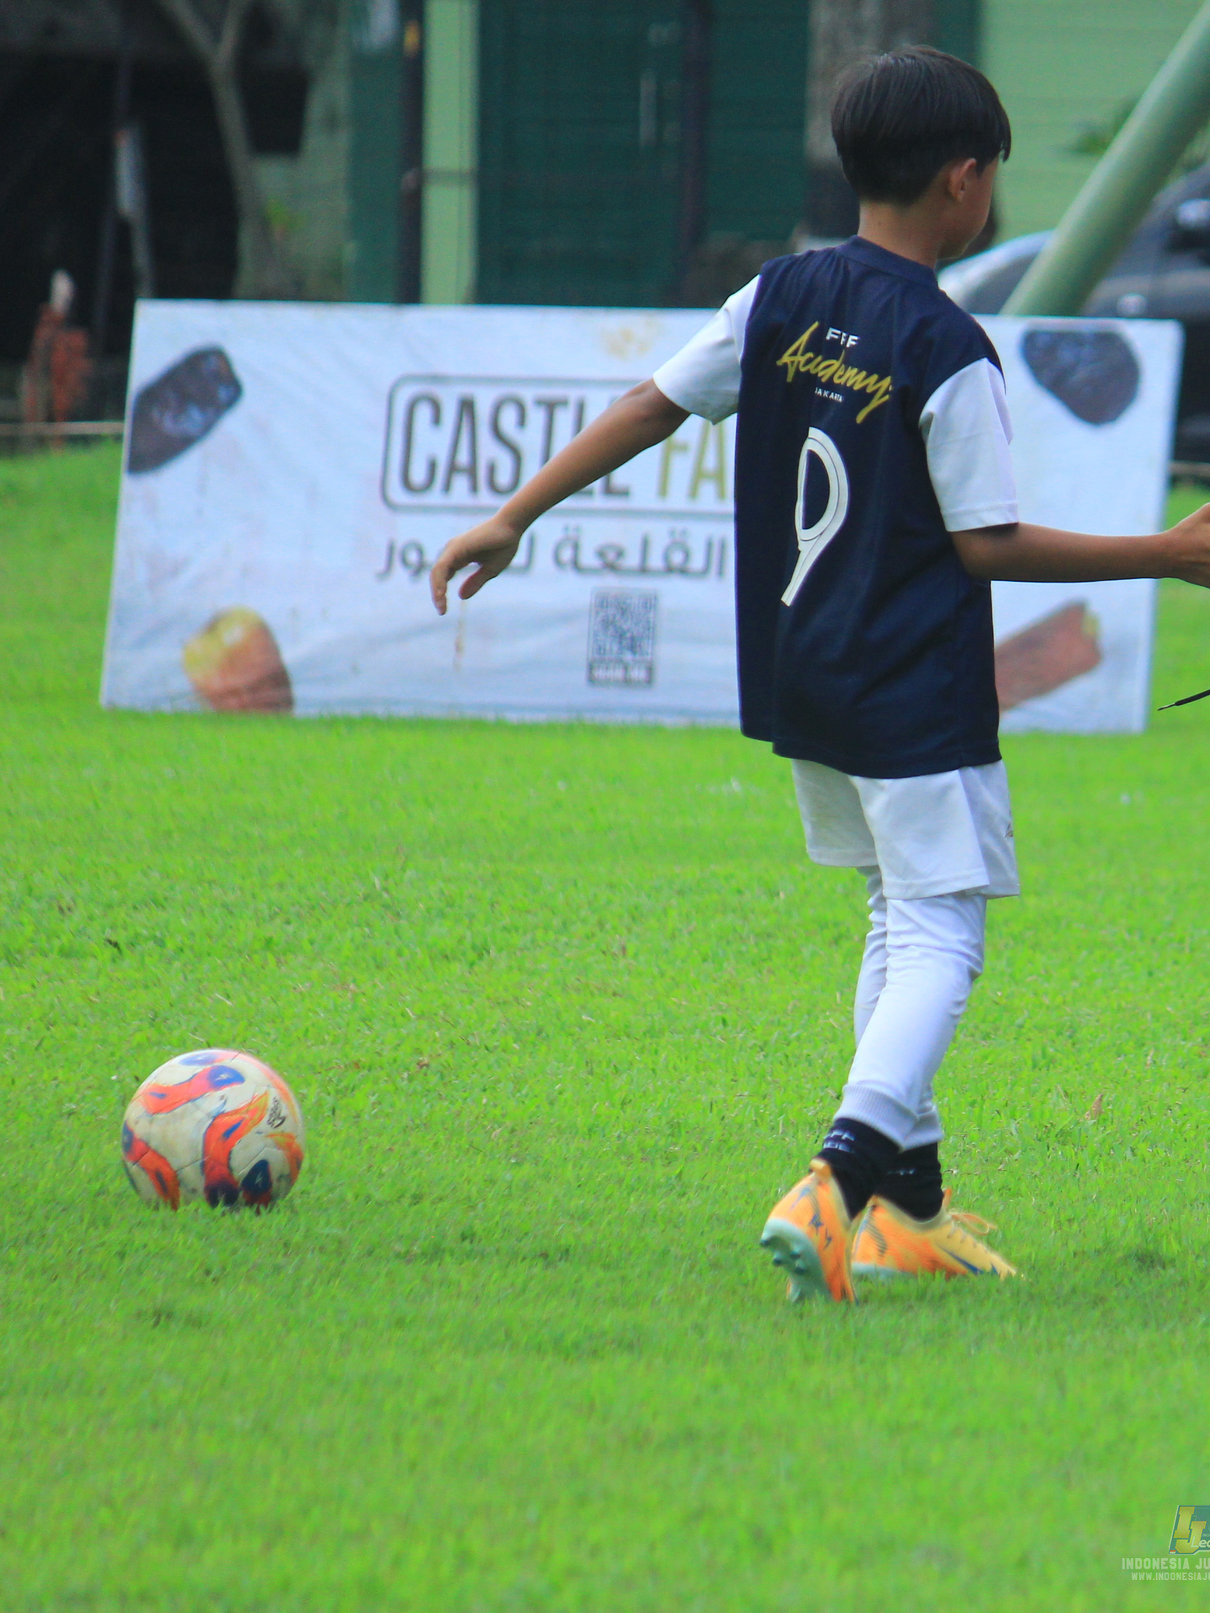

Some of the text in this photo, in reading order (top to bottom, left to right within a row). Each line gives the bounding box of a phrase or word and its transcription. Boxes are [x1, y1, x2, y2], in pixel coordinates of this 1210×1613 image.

[776, 321, 892, 424] Academy
[401, 393, 630, 496] CASTL
[553, 523, 727, 581] القلعة
[780, 426, 849, 607] 9
